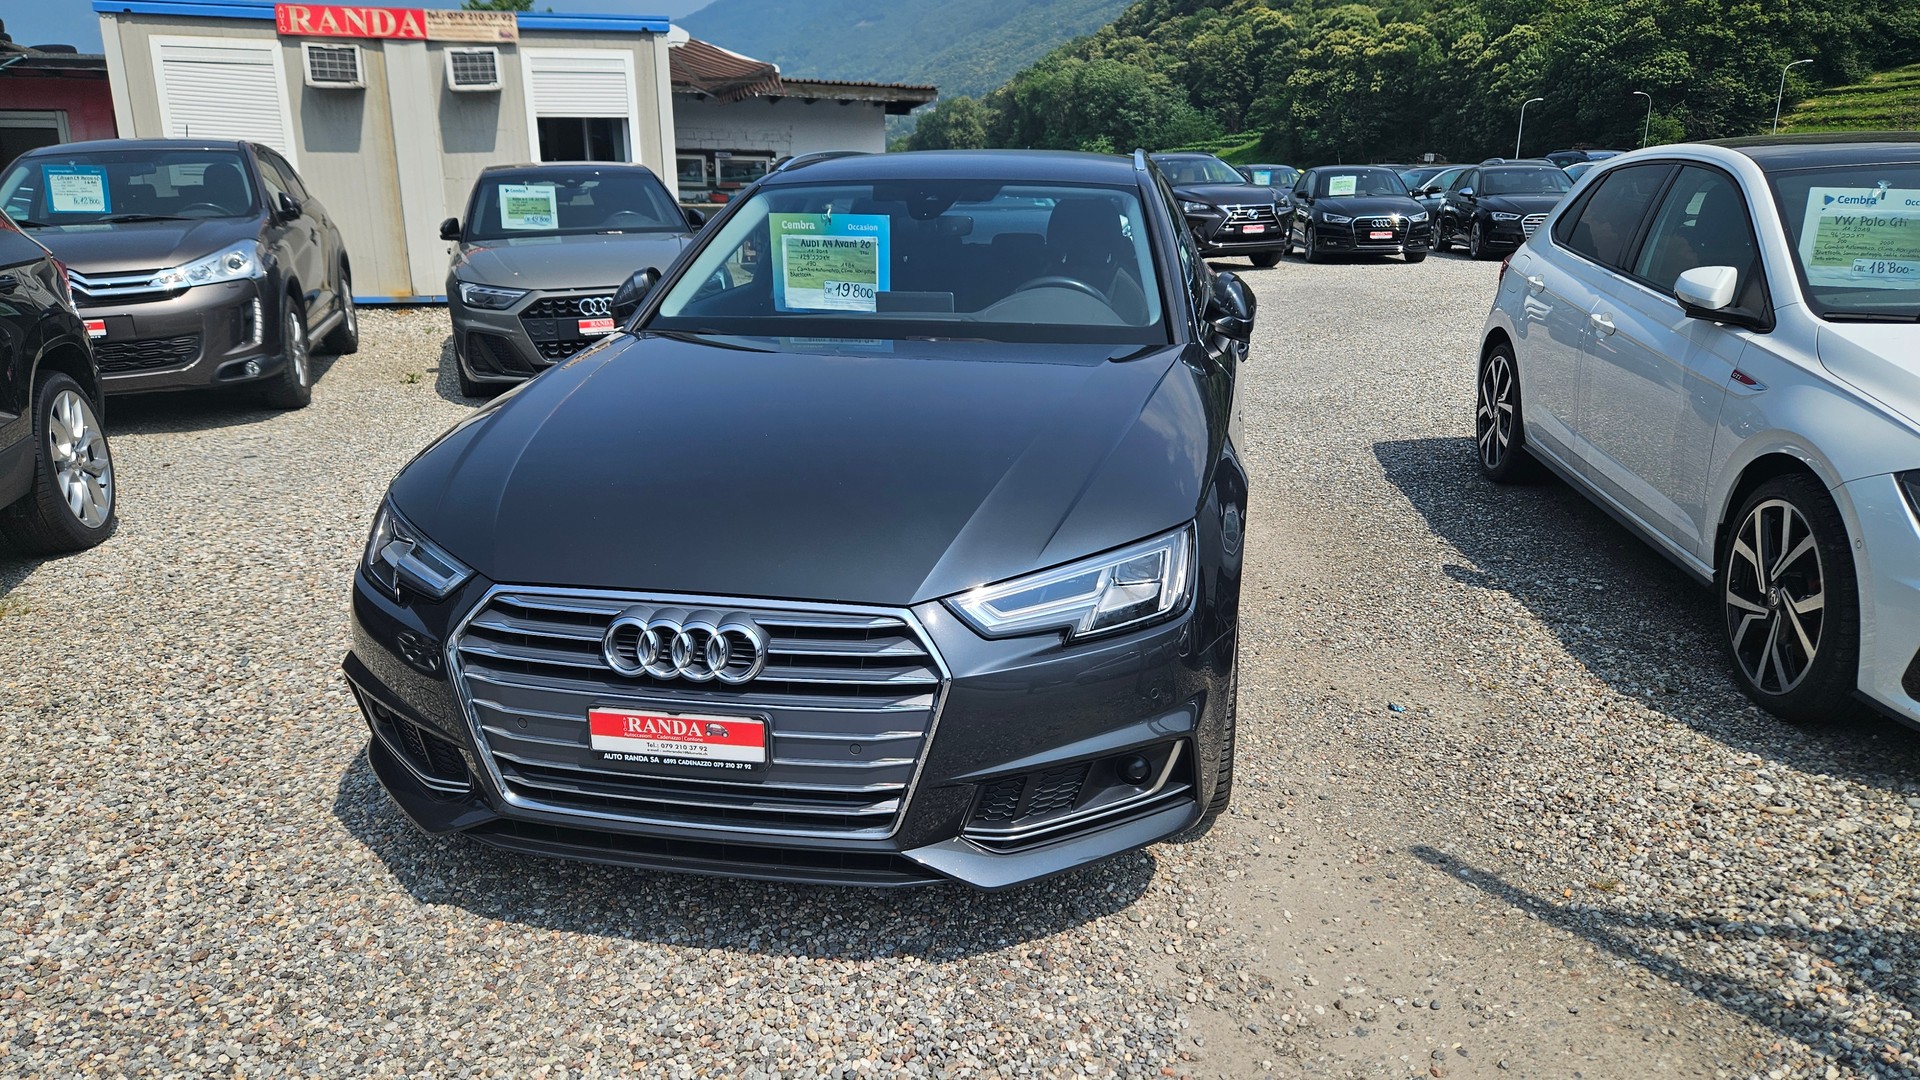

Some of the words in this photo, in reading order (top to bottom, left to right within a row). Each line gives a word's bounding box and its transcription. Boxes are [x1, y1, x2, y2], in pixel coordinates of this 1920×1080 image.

[278, 6, 286, 32] AUTO
[468, 12, 484, 20] 210
[286, 6, 425, 37] RANDA
[1838, 196, 1877, 204] Cembra
[782, 220, 816, 230] Cembra
[1834, 216, 1856, 225] VW
[1860, 216, 1886, 226] Polo
[822, 240, 832, 248] A4
[834, 240, 857, 248] Avant
[628, 717, 702, 736] RANDA
[624, 754, 648, 762] RANDA
